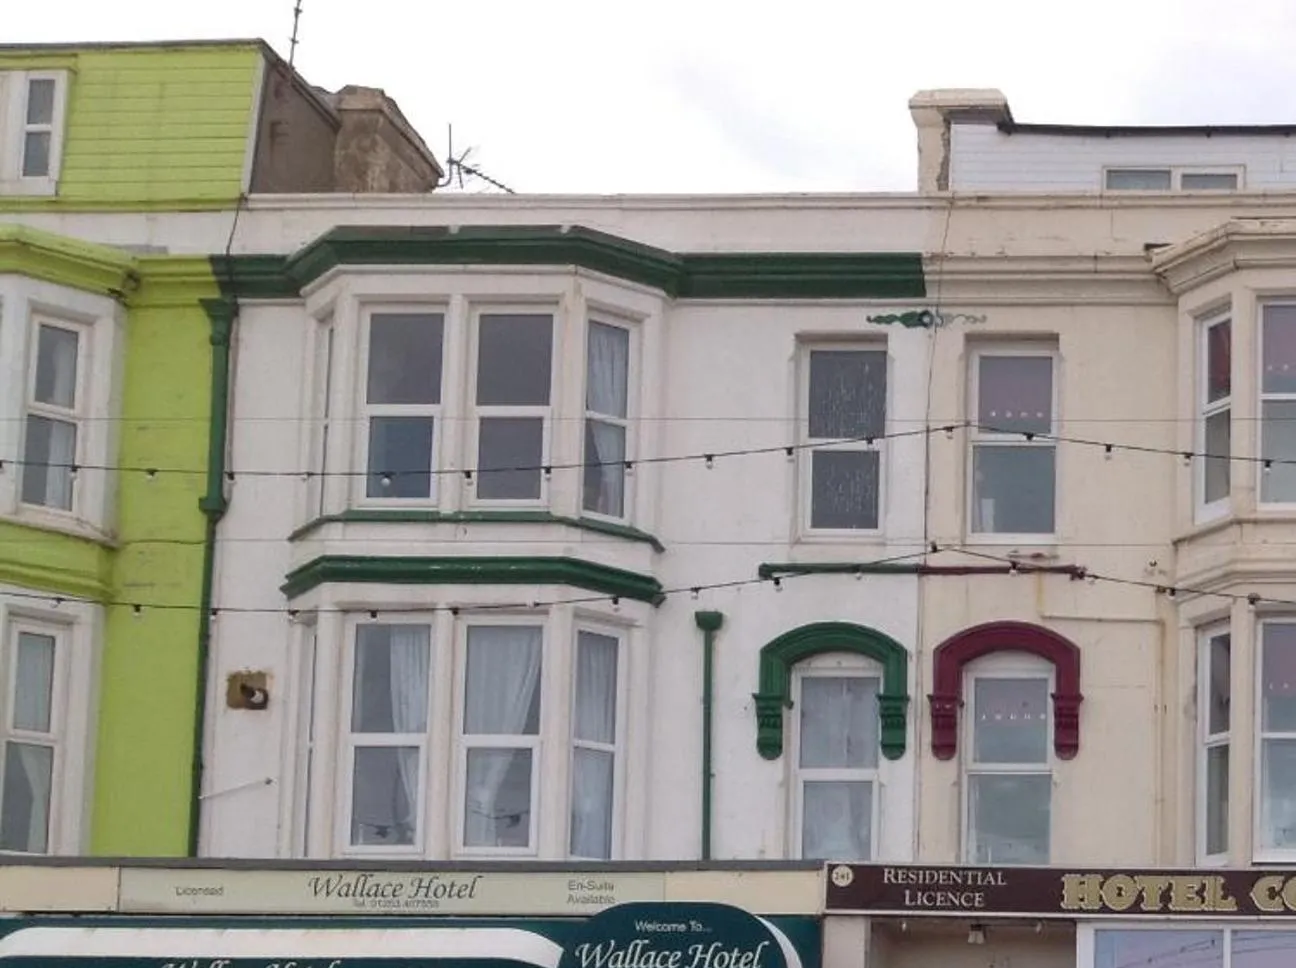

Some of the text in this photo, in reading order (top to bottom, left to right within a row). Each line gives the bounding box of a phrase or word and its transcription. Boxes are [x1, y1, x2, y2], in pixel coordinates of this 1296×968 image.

[883, 868, 1007, 886] RESIDENTIAL
[308, 873, 484, 900] Wallace Hotel
[1060, 874, 1238, 912] HOTEL
[905, 889, 985, 907] LICENCE
[634, 919, 687, 933] Welcome
